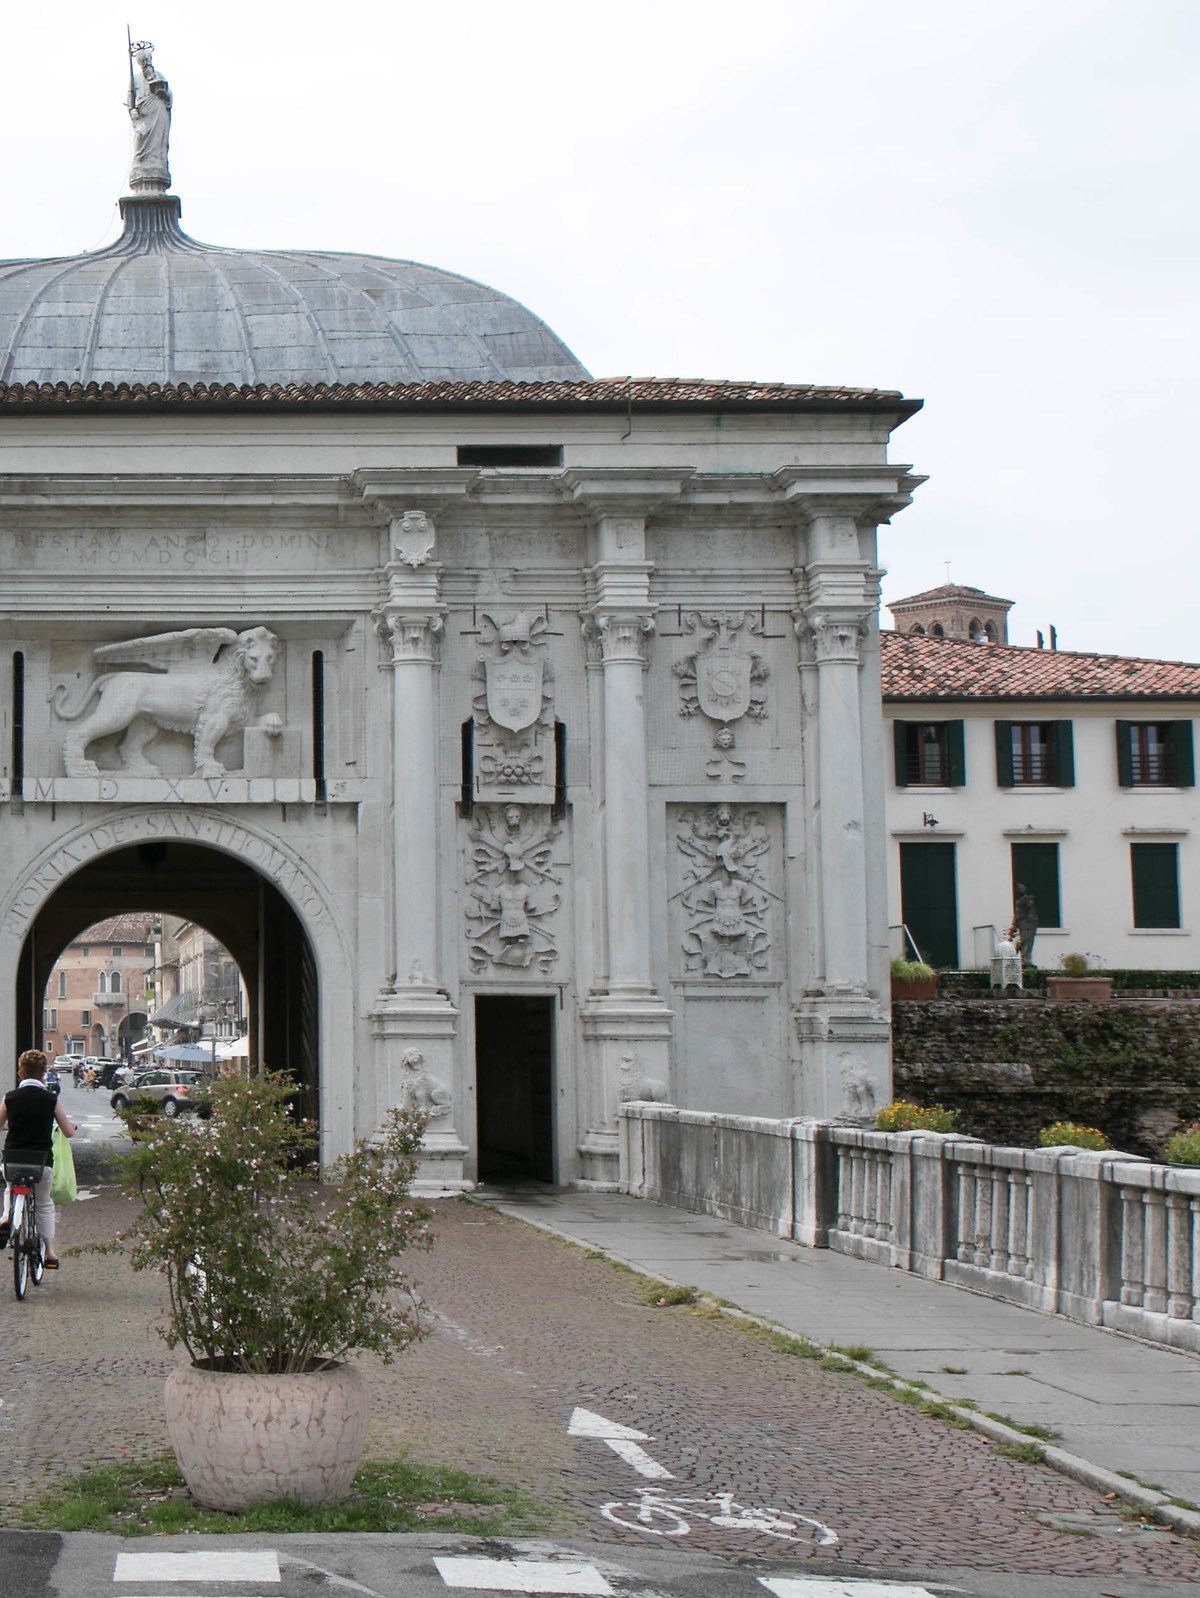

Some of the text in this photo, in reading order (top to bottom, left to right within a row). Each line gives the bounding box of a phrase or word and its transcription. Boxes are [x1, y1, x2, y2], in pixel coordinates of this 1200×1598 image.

[10, 848, 83, 920] PORTA
[89, 820, 128, 850] DE
[145, 814, 202, 837] SAN
